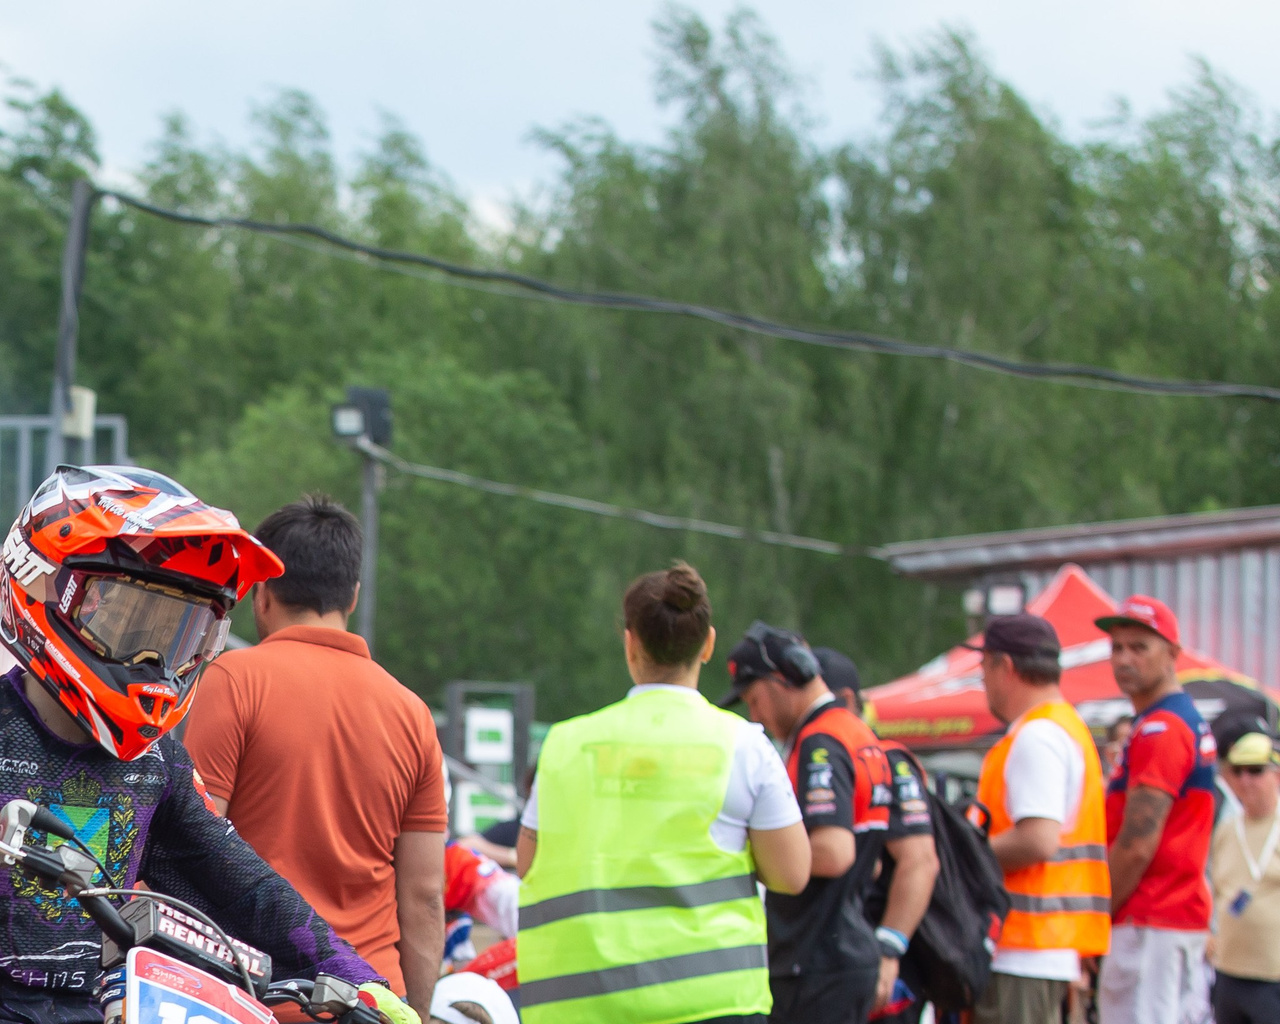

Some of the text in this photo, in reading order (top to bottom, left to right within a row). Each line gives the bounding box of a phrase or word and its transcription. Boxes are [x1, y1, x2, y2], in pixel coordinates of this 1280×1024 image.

[59, 574, 78, 614] LEATT
[159, 917, 265, 977] RENTHAL
[150, 967, 185, 985] SHMS
